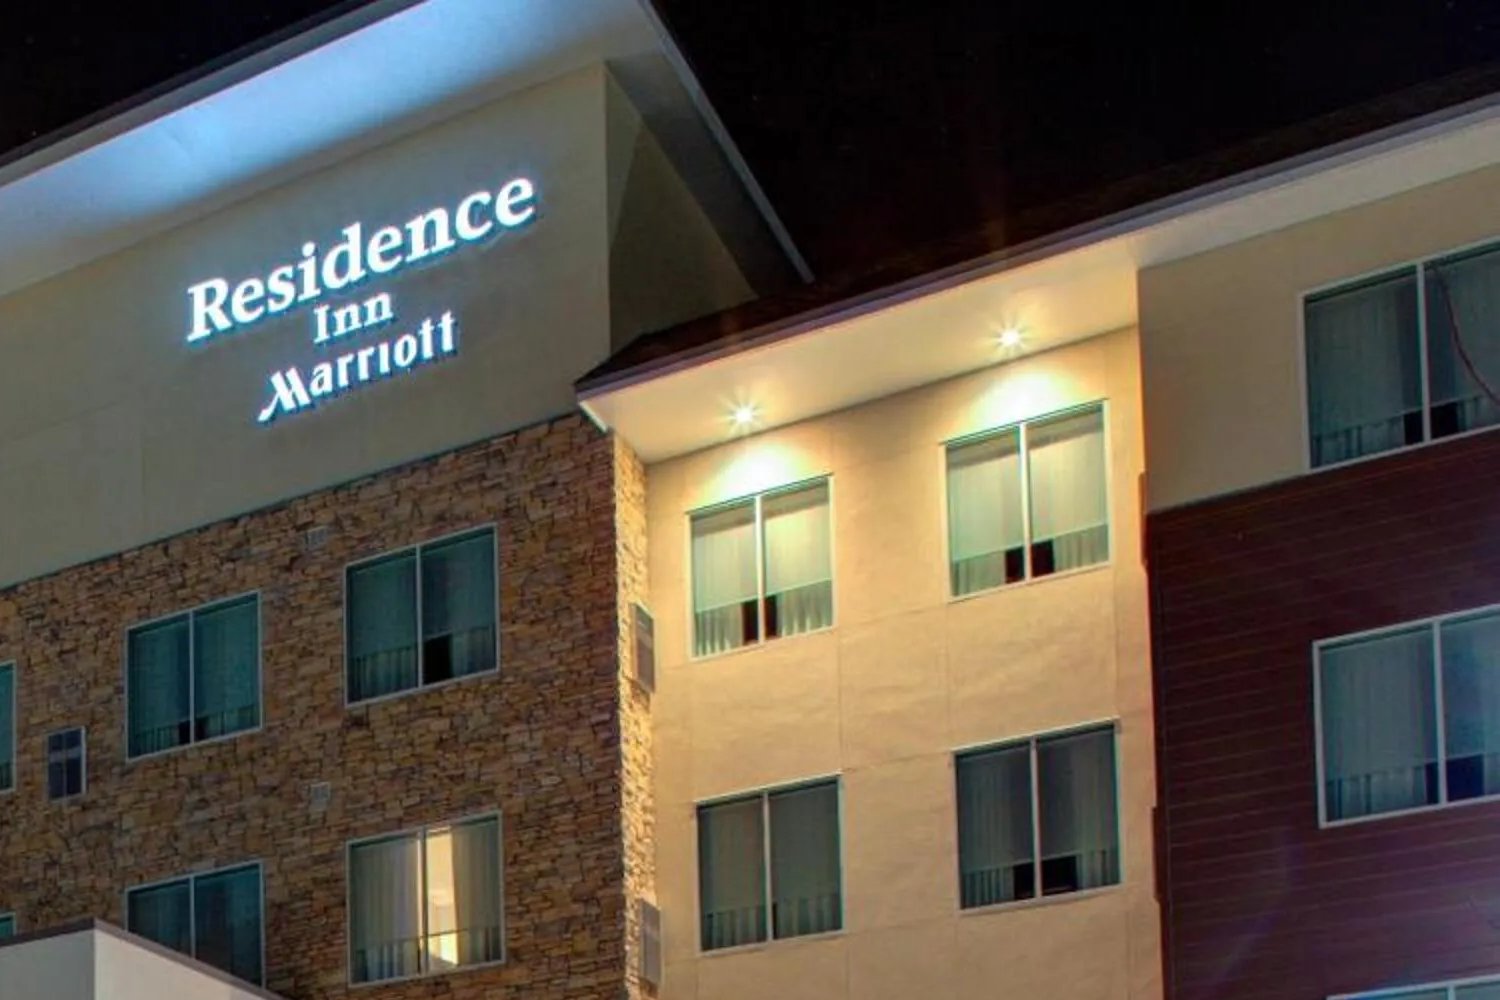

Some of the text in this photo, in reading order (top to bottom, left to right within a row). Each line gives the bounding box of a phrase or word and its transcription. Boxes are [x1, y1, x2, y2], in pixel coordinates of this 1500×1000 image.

[186, 177, 535, 342] Residence
[257, 309, 457, 422] Marriott
[313, 291, 393, 344] Inn
